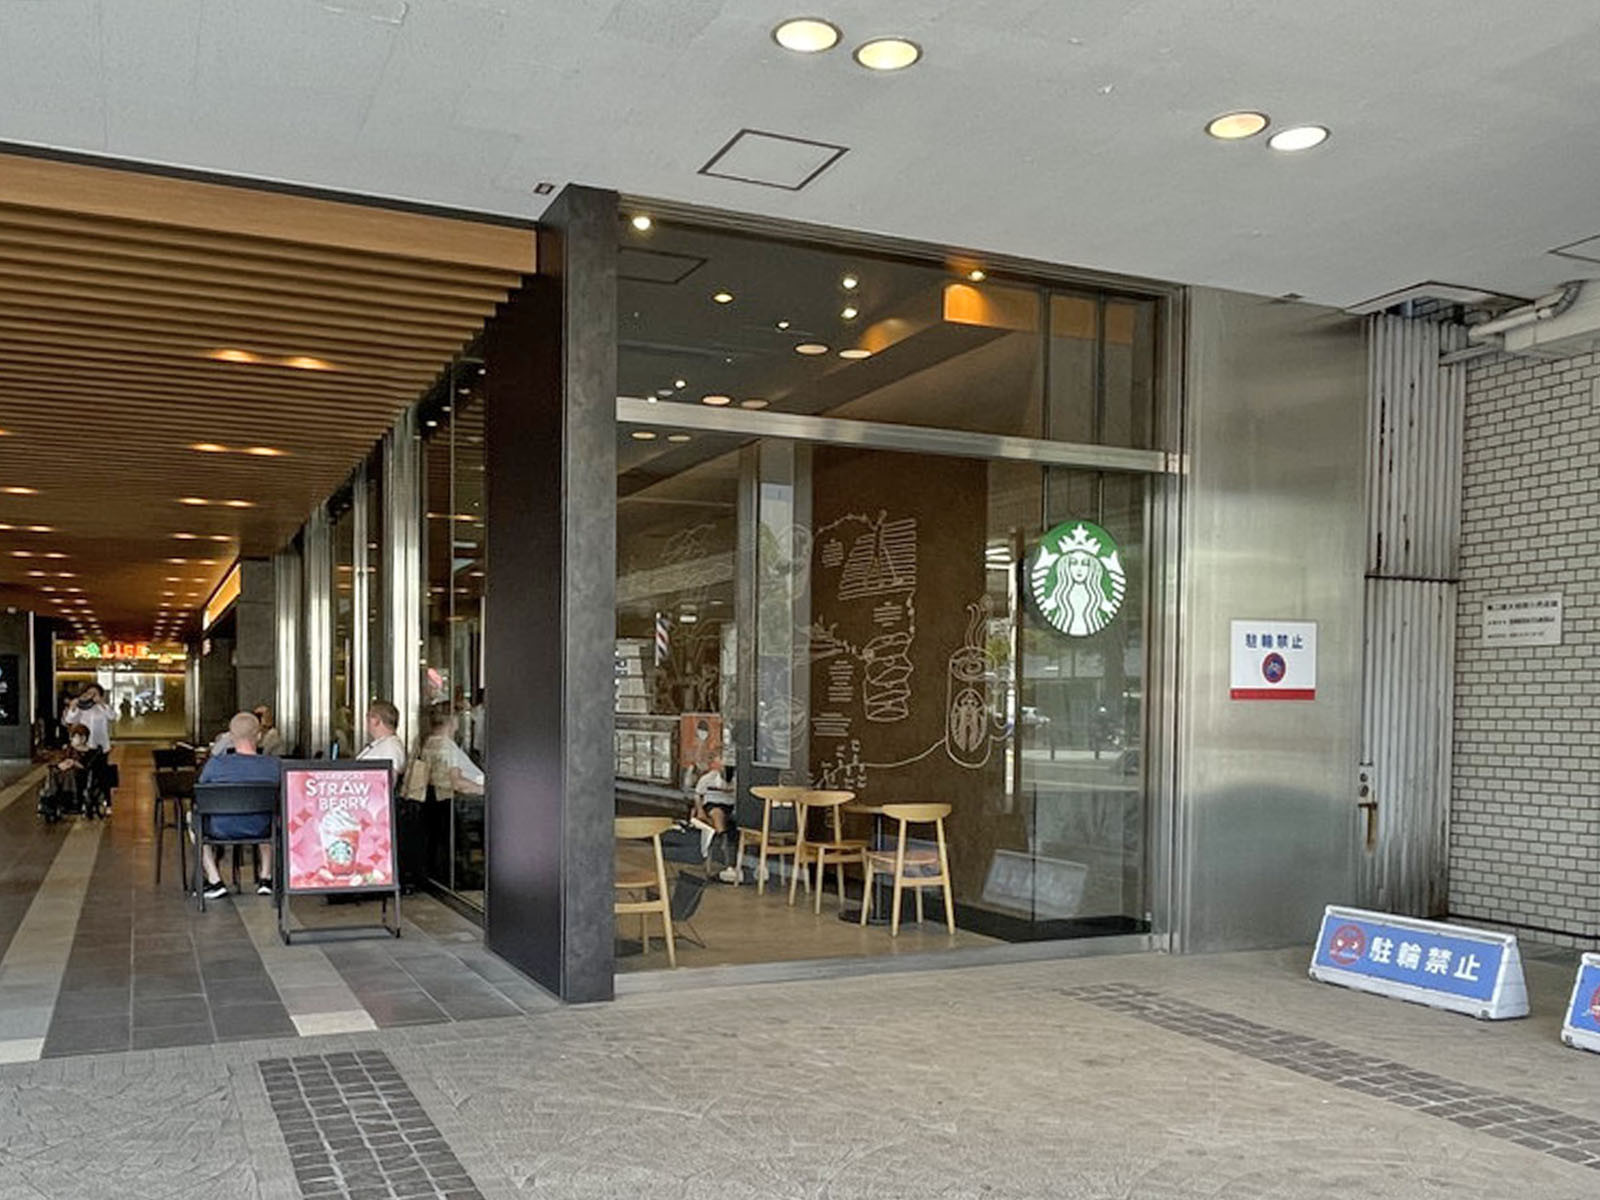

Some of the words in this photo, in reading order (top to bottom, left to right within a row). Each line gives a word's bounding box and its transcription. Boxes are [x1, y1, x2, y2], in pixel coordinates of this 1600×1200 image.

[1245, 633, 1304, 649] 駐輪禁止
[305, 779, 371, 797] STRAW
[319, 797, 369, 811] BERRY
[1369, 936, 1481, 982] 駐輪禁止
